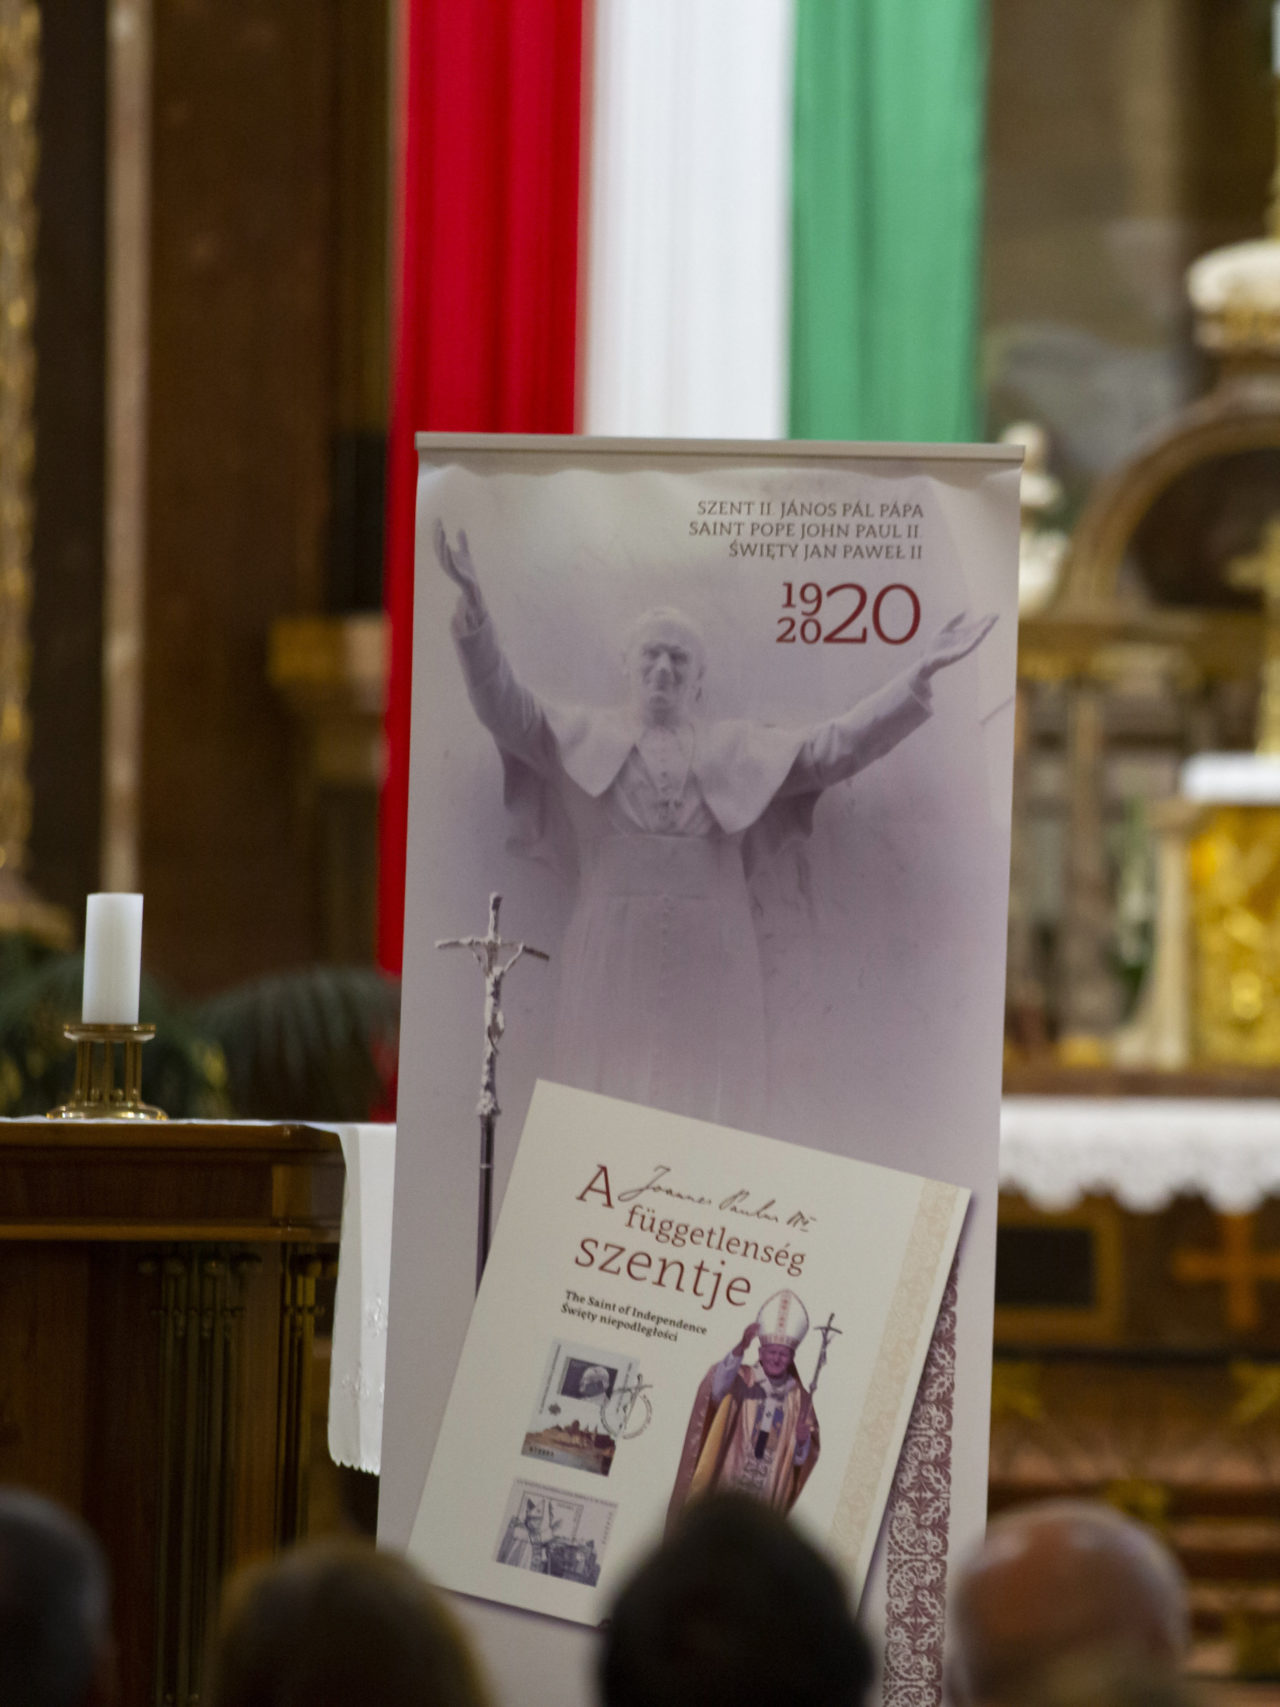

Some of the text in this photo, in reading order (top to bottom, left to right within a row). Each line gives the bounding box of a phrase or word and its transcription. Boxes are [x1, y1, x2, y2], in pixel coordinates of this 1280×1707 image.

[697, 500, 924, 519] SZENT II JÁNOS PÁL PÁPA
[689, 521, 919, 540] SAINT POPE JOHN PAUL II
[729, 540, 922, 561] ŚWIĘTY JAN PAWEŁ II
[782, 582, 822, 616] 19
[776, 616, 822, 644] 20
[576, 1164, 615, 1209] A
[625, 1204, 806, 1277] függetlenség
[574, 1237, 752, 1311] szentje
[560, 1302, 679, 1342] Święty niepodległości
[565, 1290, 708, 1336] The Saint of Independence
